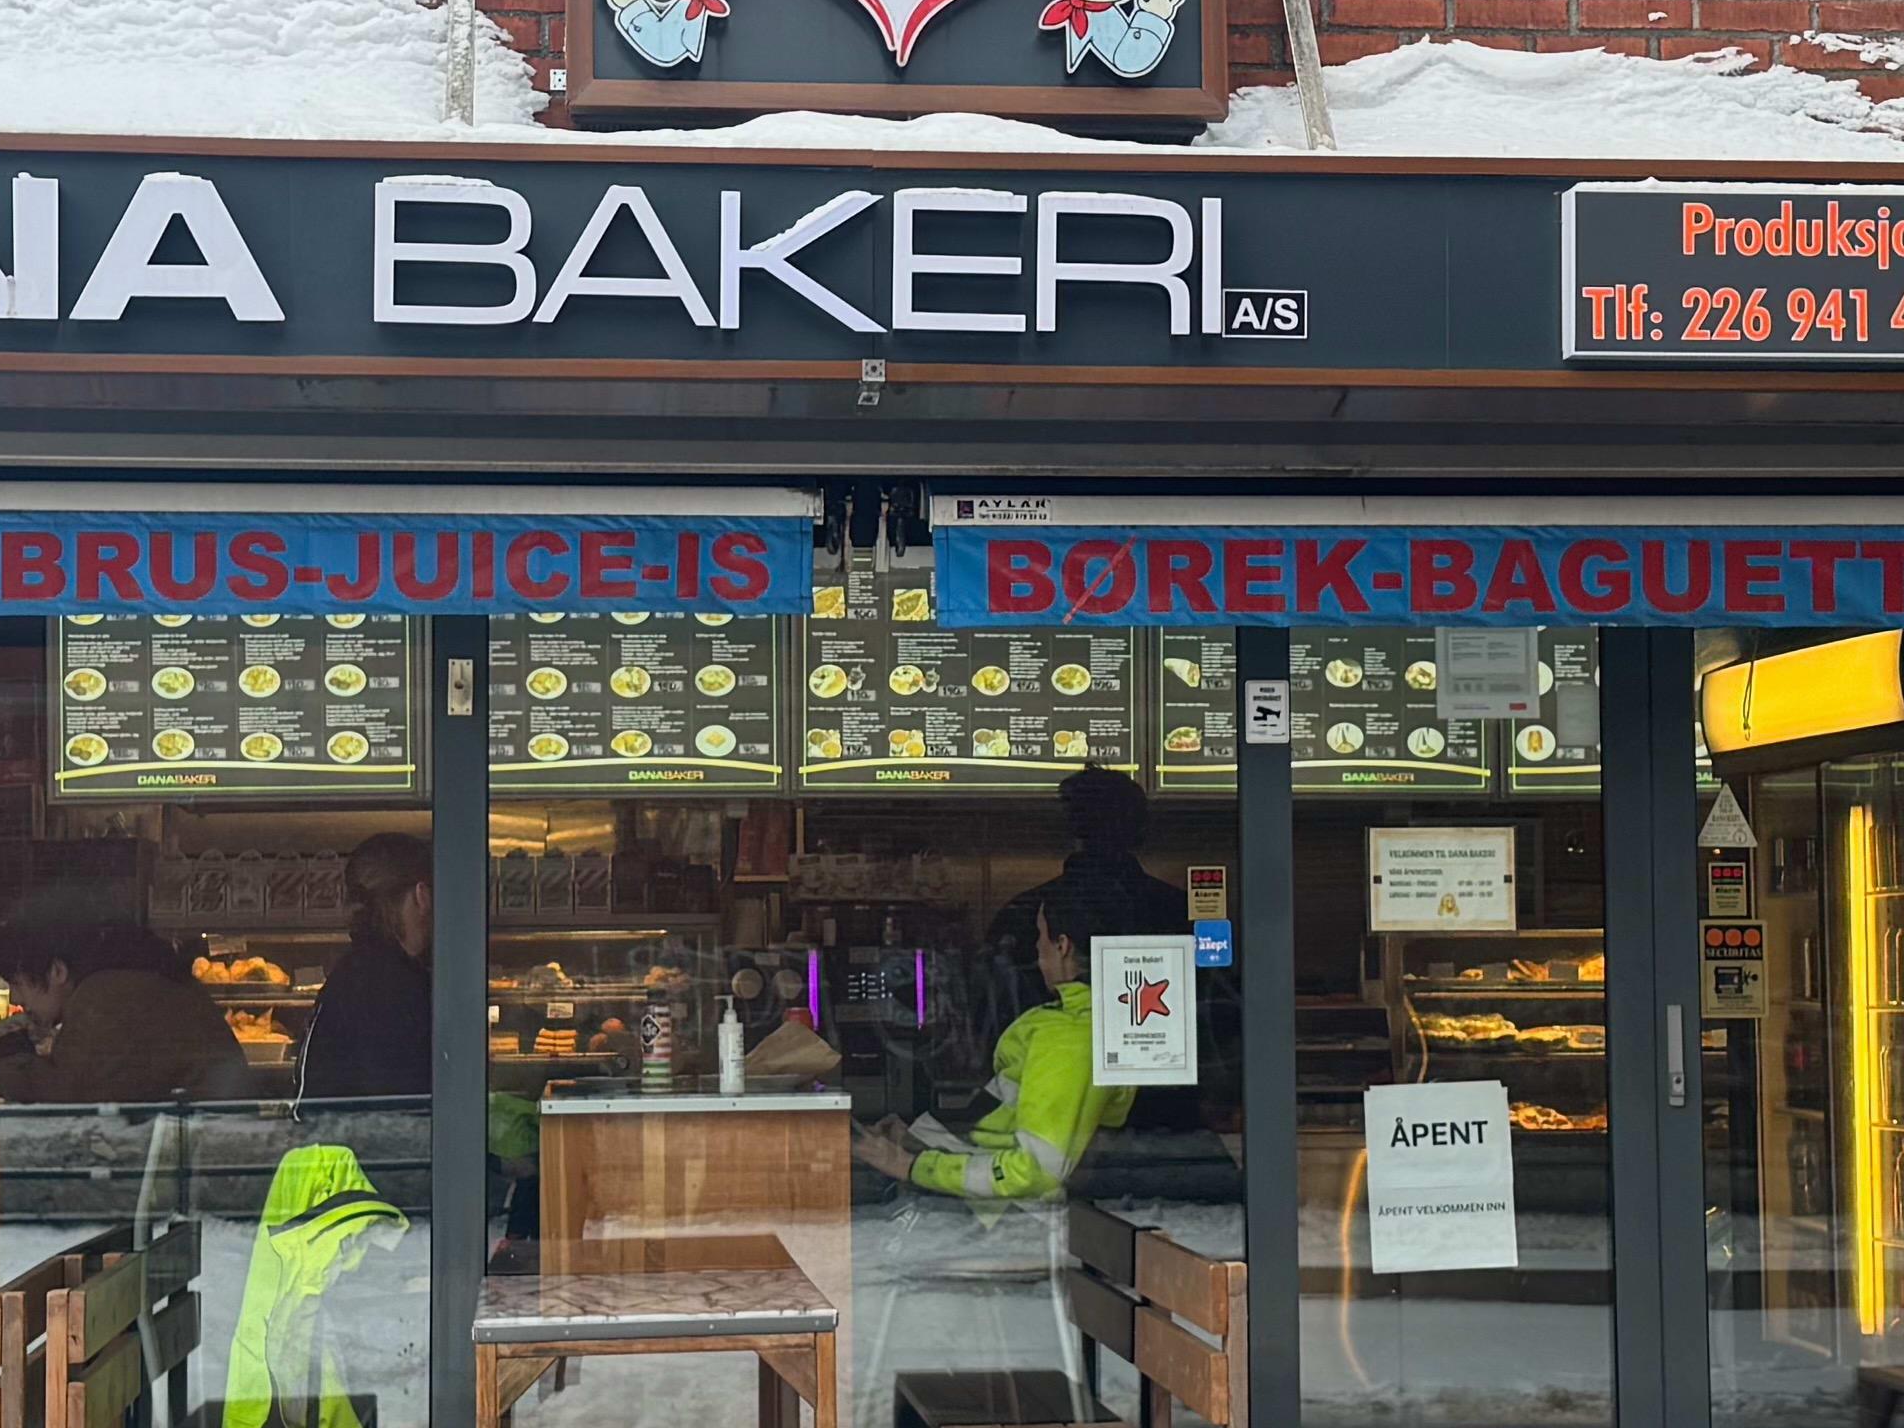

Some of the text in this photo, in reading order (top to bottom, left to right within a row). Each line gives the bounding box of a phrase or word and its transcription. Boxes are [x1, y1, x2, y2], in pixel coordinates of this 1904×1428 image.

[372, 181, 1221, 335] BAKERI
[1232, 297, 1301, 334] A/S
[1582, 285, 1663, 342] Tlf:
[1682, 287, 1772, 343] 226
[1787, 288, 1868, 343] 941
[1390, 1117, 1488, 1148] ÅPENT
[1377, 1201, 1506, 1217] ÅPENT VELKOMMEN INN
